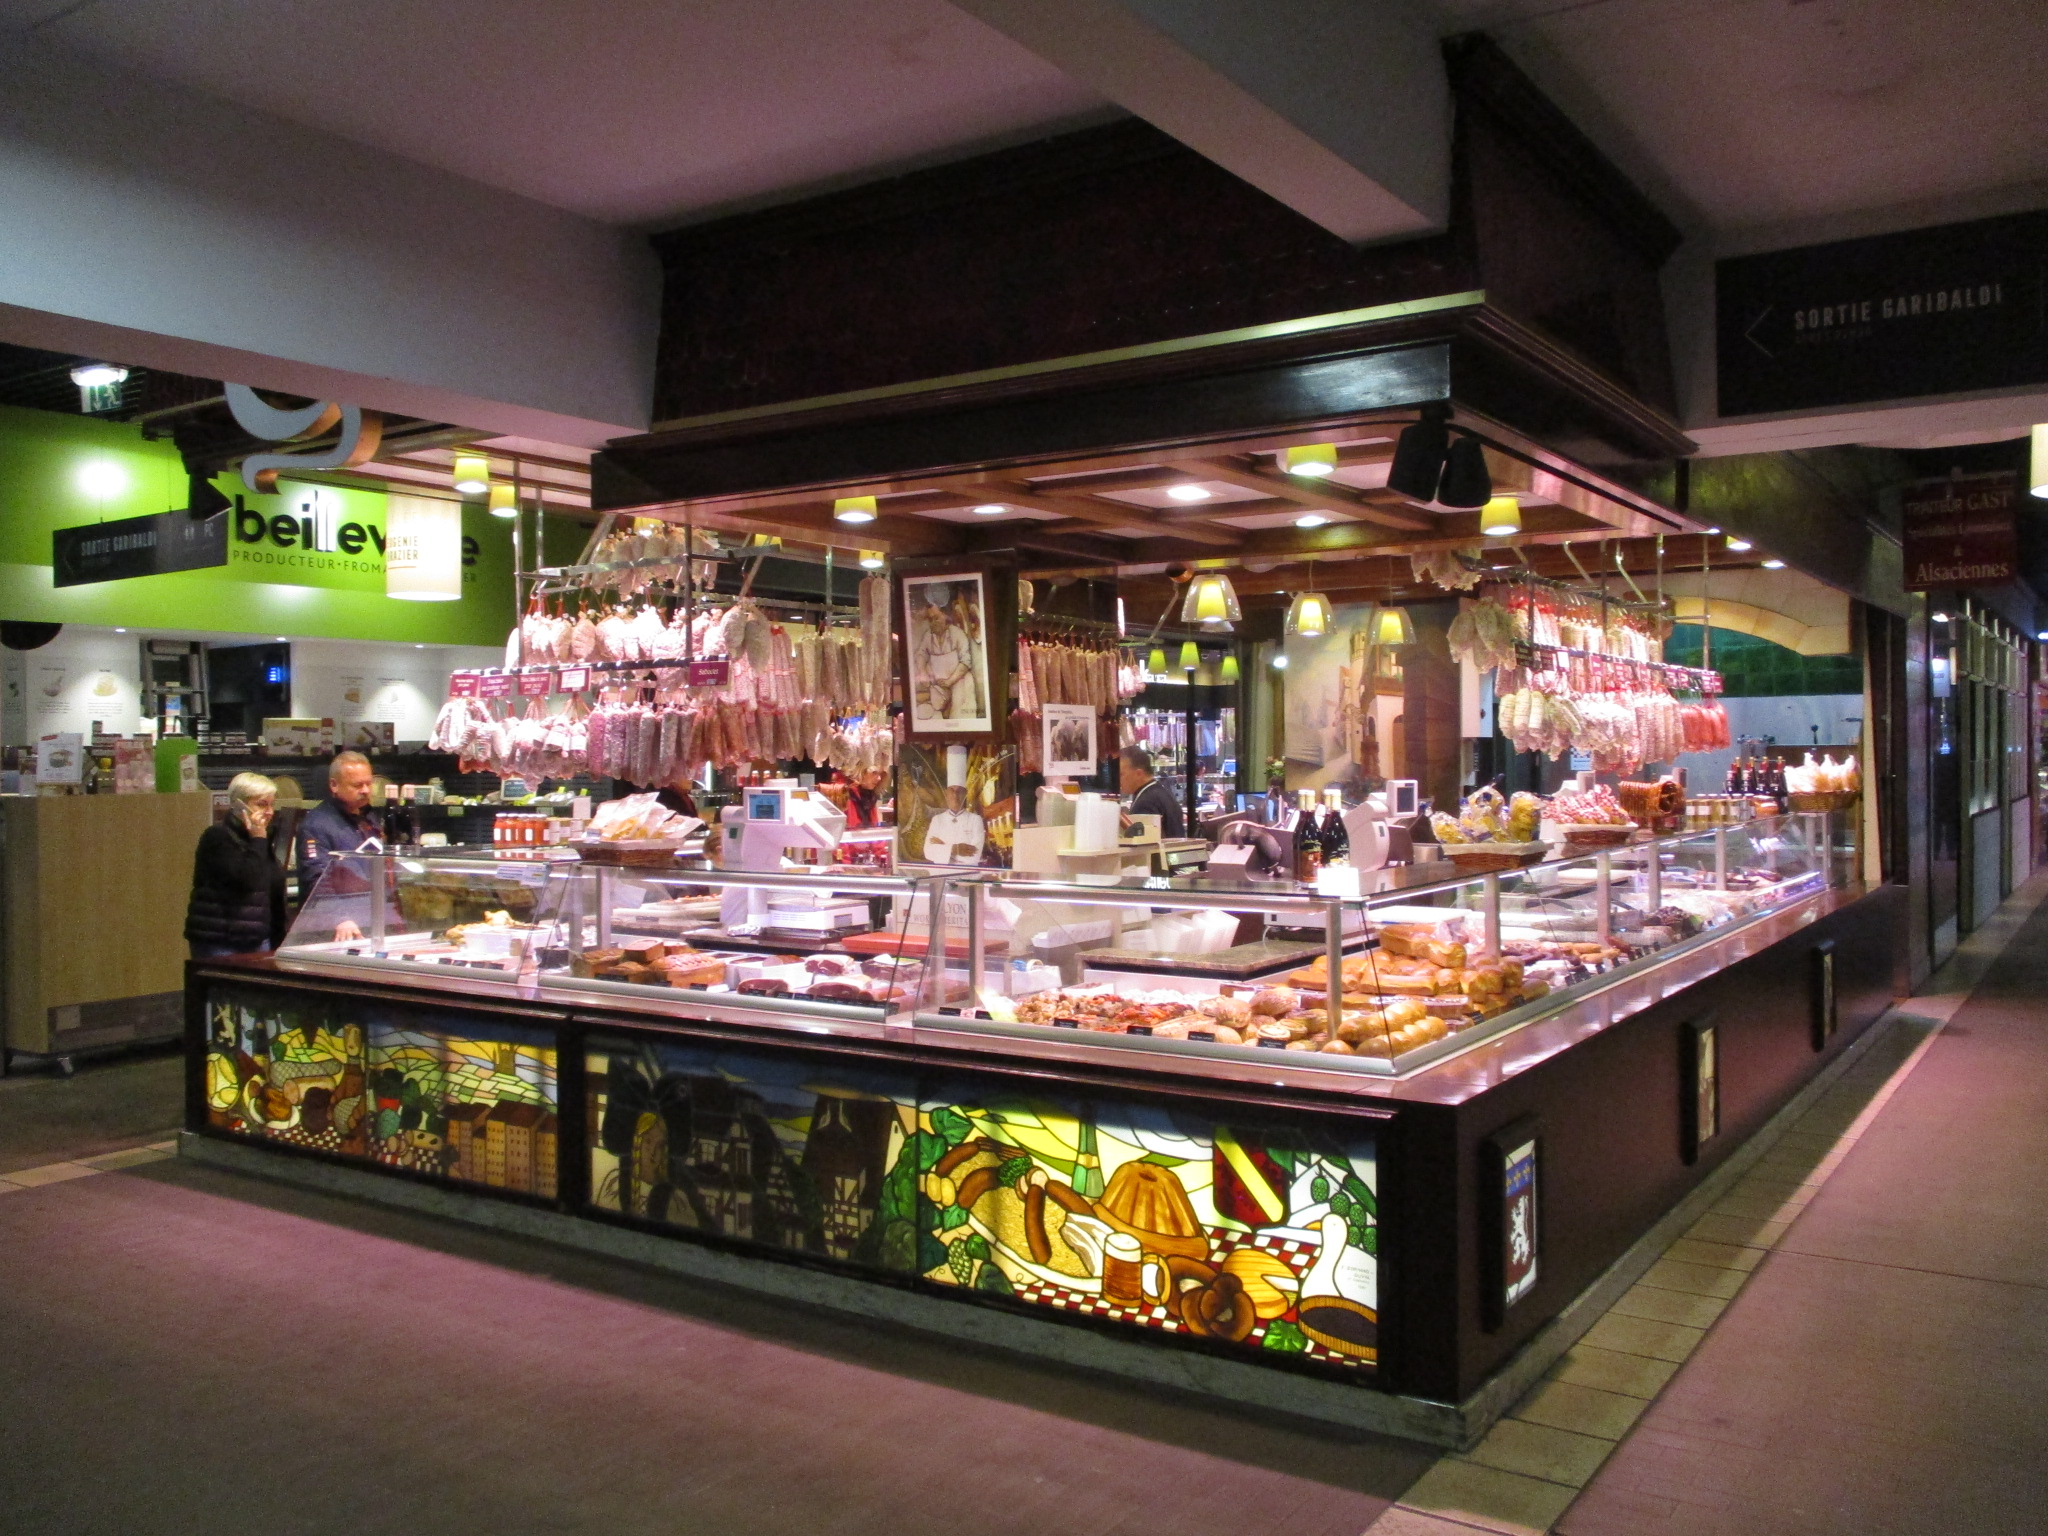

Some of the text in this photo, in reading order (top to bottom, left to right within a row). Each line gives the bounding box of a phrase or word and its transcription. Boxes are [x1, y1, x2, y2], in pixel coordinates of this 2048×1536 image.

[1794, 283, 2002, 330] SORTIE GARIBALDI
[1915, 561, 2010, 583] Alsaciennes
